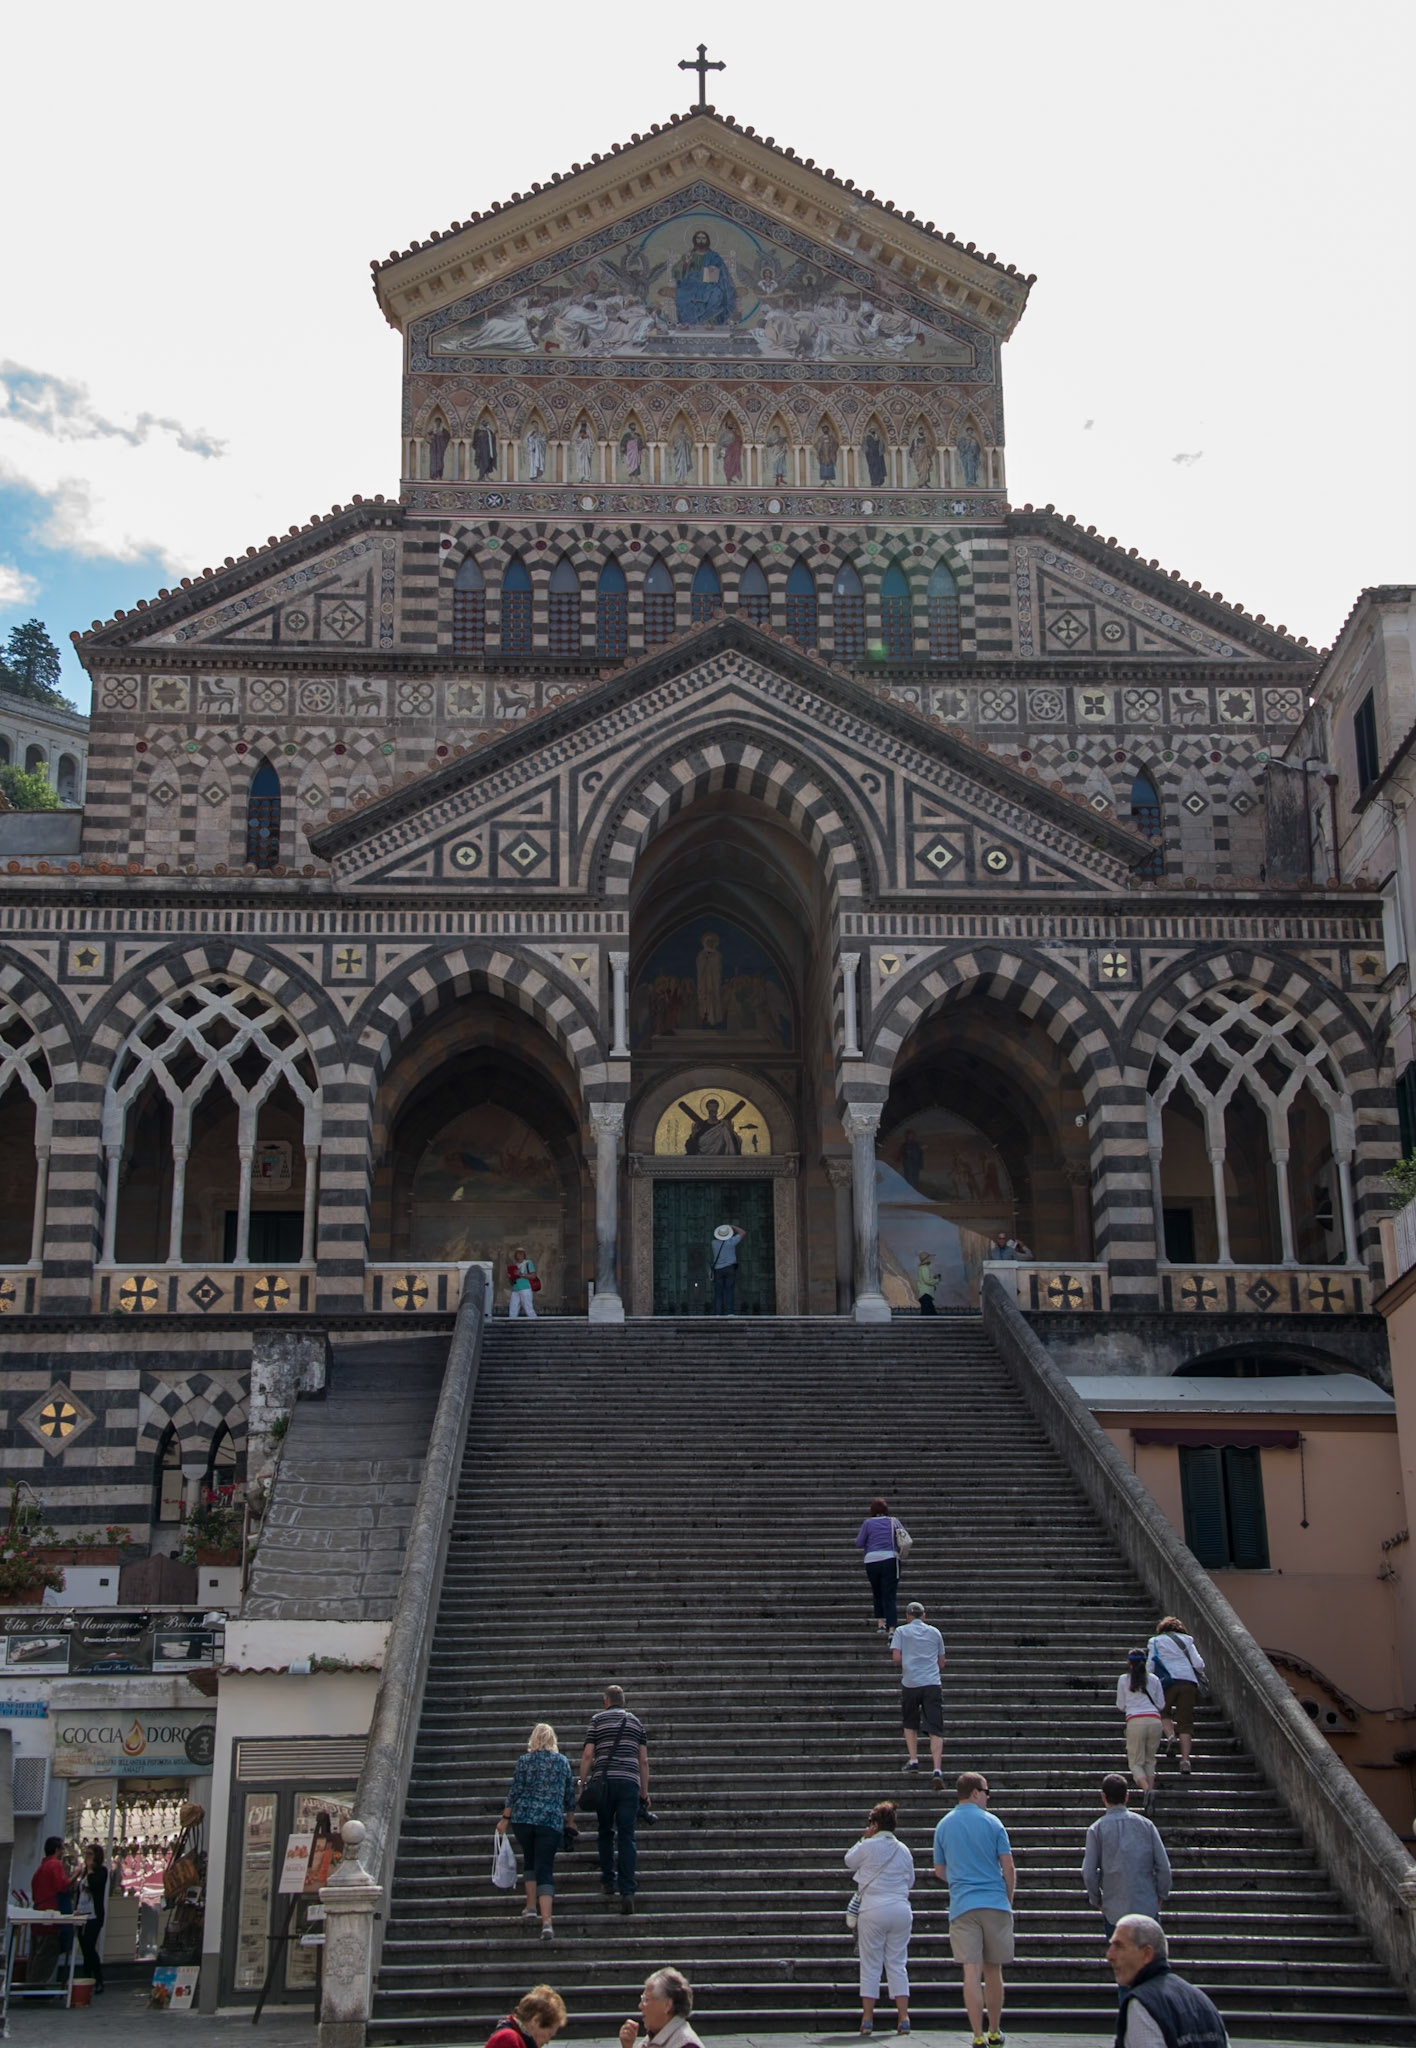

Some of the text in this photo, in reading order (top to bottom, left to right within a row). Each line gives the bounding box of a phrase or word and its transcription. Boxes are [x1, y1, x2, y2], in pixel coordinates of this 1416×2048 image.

[4, 1616, 29, 1631] Elite
[32, 1616, 65, 1633] Yach
[80, 1616, 139, 1634] Managemen
[63, 1726, 191, 1744] GOCCIA D'ORO
